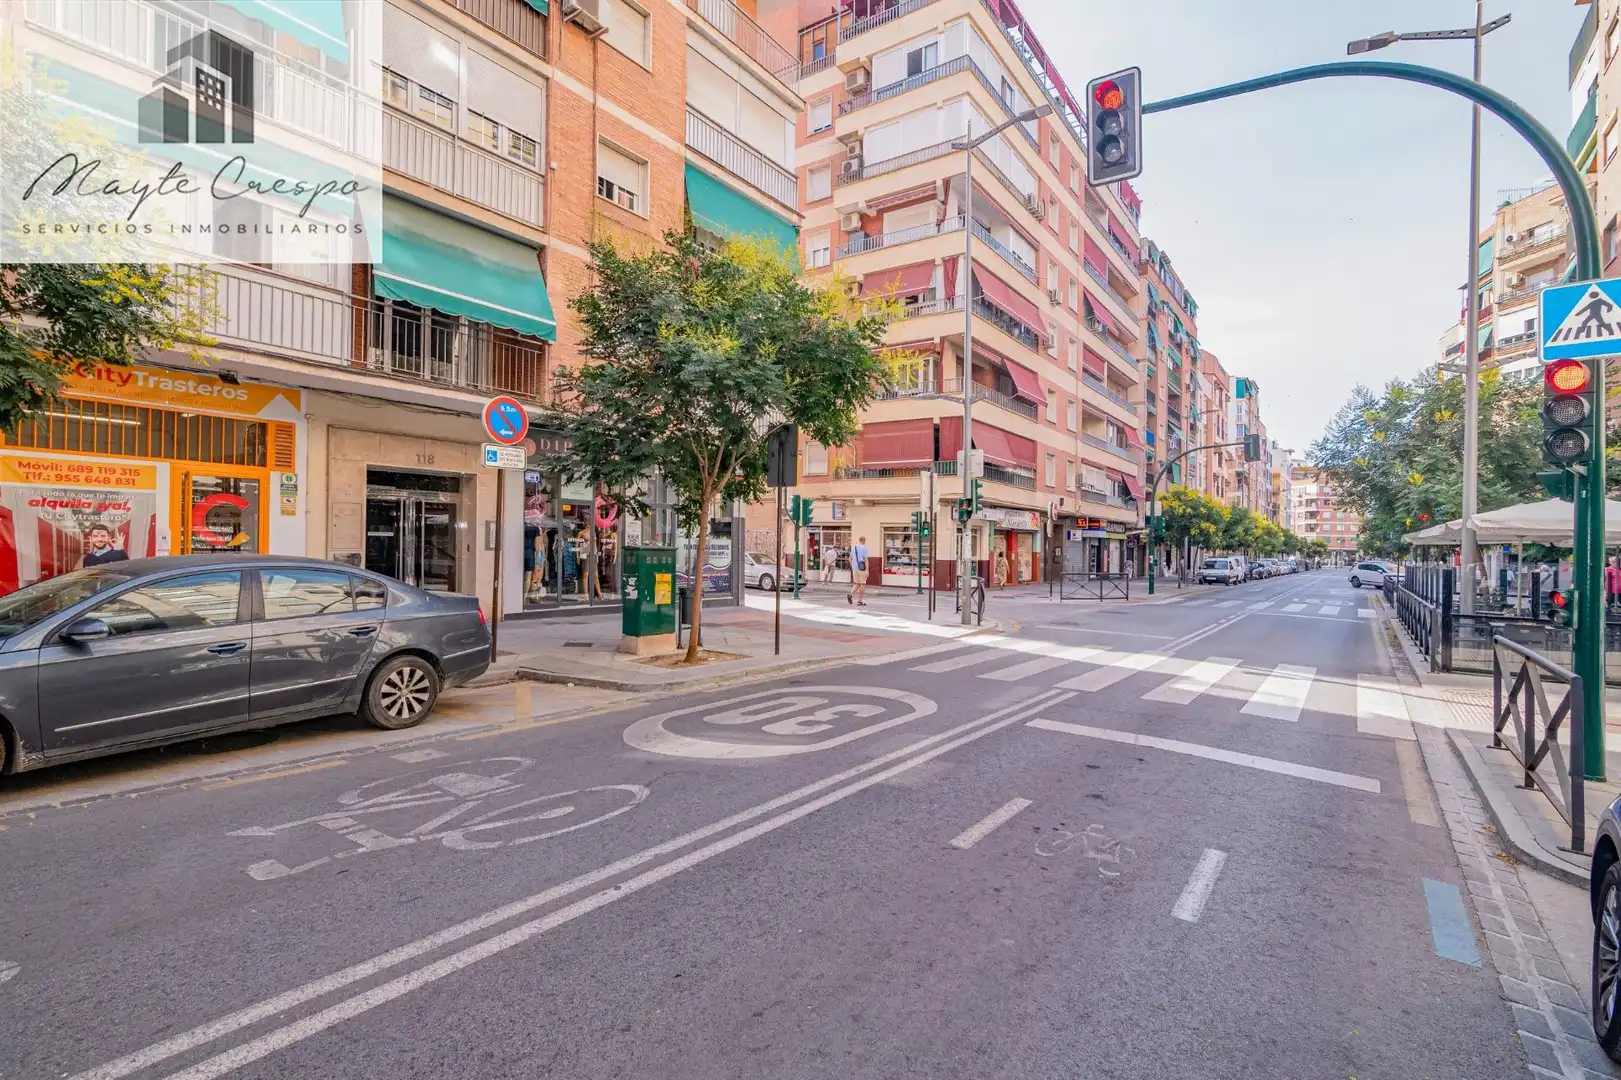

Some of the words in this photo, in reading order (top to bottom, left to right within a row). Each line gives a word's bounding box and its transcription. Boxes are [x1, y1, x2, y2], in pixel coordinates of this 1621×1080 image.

[415, 453, 435, 465] 118
[17, 460, 63, 472] Móvil:
[67, 464, 94, 474] 689
[98, 466, 117, 475] 119
[119, 467, 141, 477] 315
[54, 473, 81, 483] 955
[84, 475, 111, 485] 648
[115, 477, 136, 486] 831
[28, 496, 92, 511] alquila
